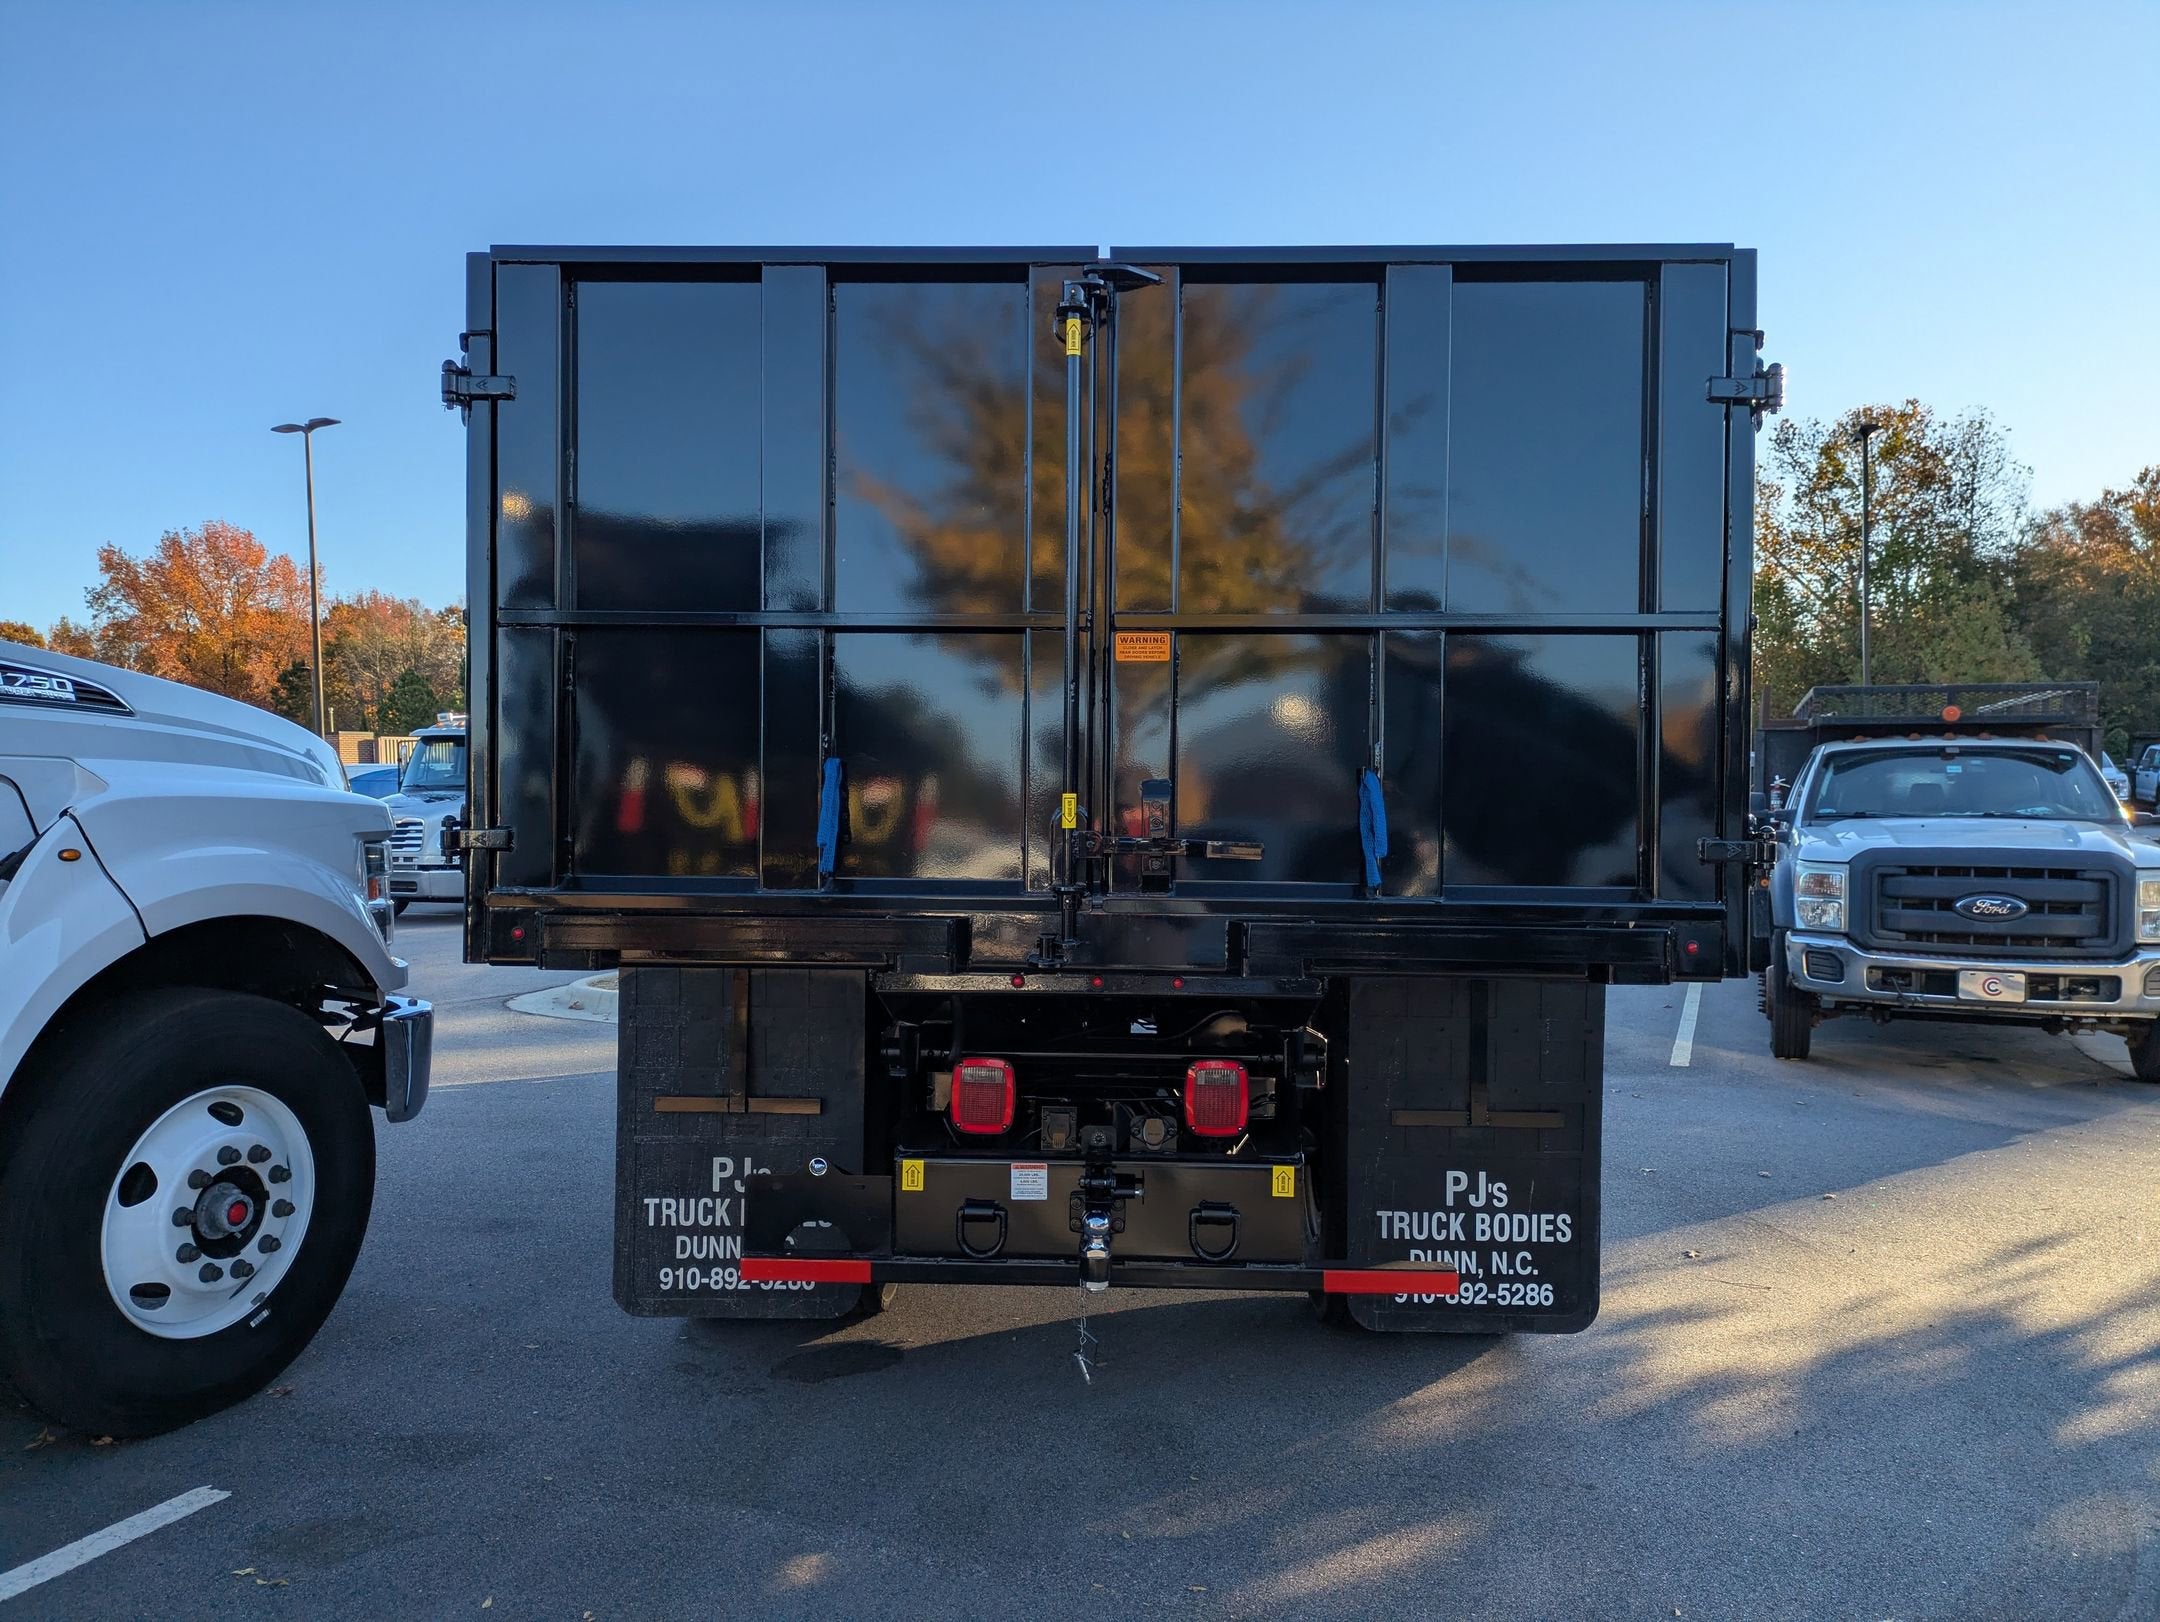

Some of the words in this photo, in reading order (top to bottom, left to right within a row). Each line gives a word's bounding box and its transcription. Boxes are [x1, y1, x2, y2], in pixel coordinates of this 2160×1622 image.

[1120, 636, 1166, 644] WARNING
[0, 672, 74, 693] 750
[1973, 899, 2011, 914] Ford
[1446, 1171, 1508, 1207] PJ's
[644, 1198, 731, 1227] TRUCK
[1376, 1211, 1466, 1241] TRUCK
[1475, 1213, 1572, 1243] BODIES
[676, 1235, 742, 1260] DUNN
[1491, 1251, 1539, 1276] N.C.
